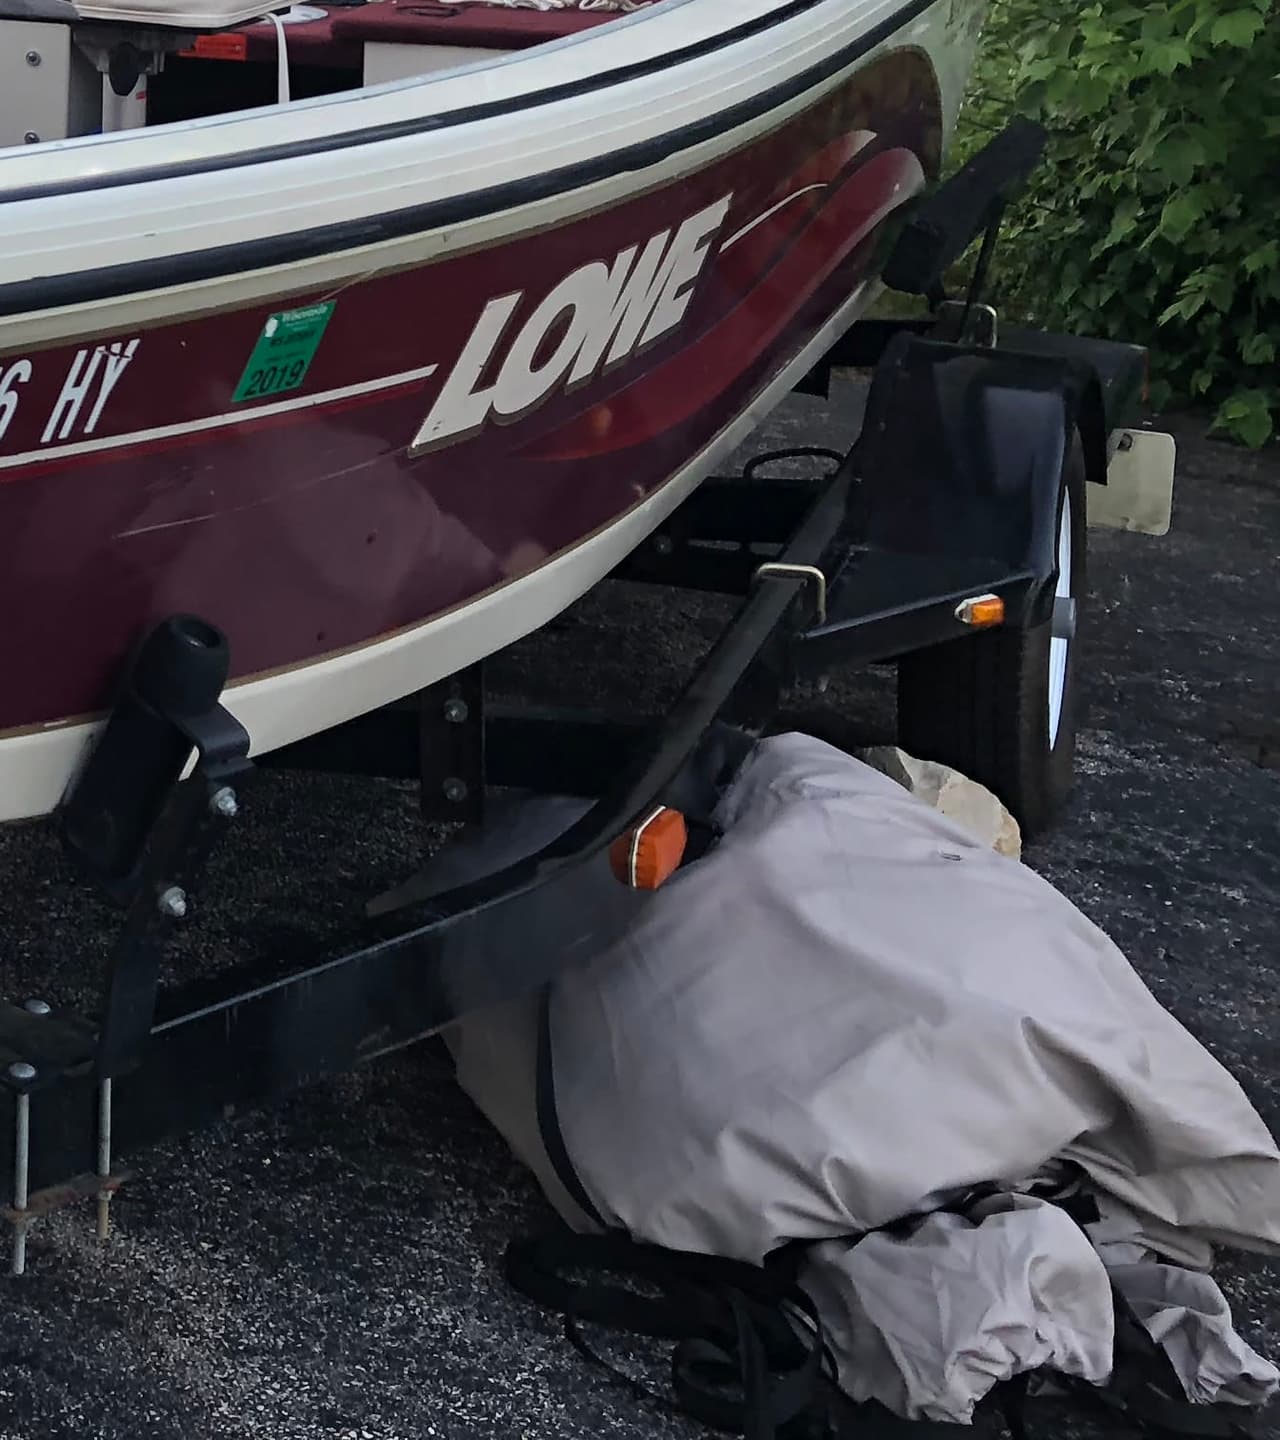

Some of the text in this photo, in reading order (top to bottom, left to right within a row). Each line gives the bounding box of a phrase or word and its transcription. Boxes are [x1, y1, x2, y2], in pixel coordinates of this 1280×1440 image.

[410, 191, 733, 449] LOWE
[40, 339, 140, 443] HY
[244, 360, 305, 396] 2019
